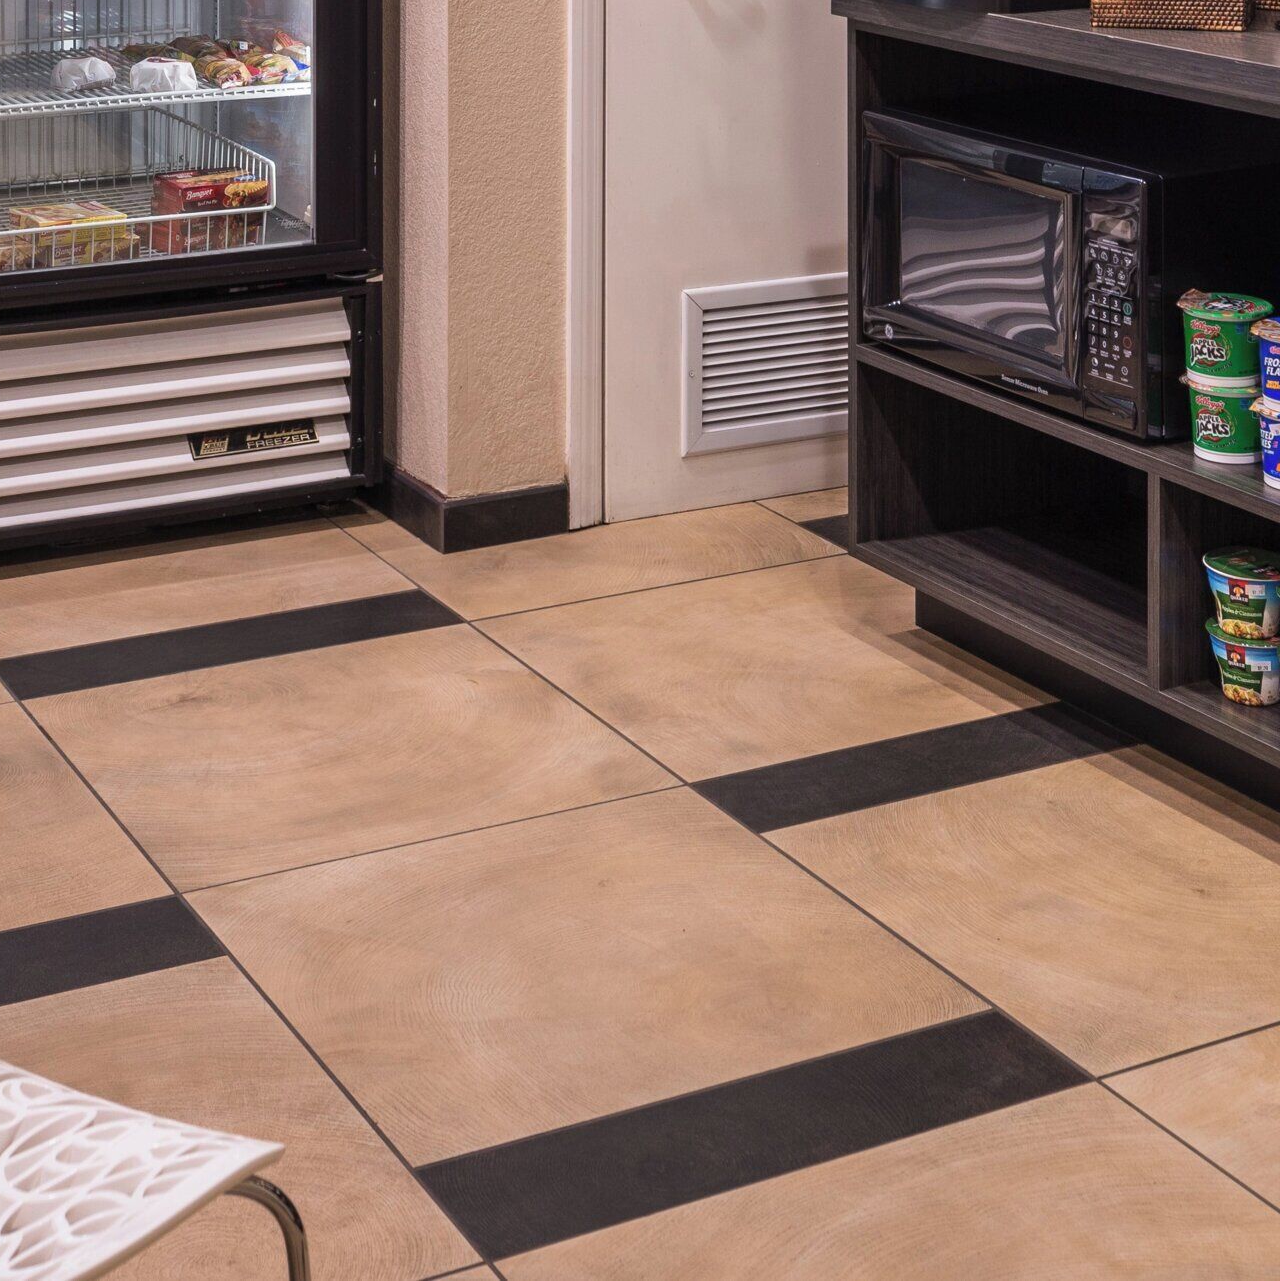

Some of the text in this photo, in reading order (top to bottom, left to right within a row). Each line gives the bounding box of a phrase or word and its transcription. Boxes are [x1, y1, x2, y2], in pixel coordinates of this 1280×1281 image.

[186, 187, 214, 201] Banquet
[1191, 319, 1221, 335] Kellogg's
[1194, 339, 1216, 348] APPLE
[1190, 345, 1226, 366] JACKS
[1196, 395, 1224, 410] Kellogg's
[1199, 414, 1220, 423] APPLE
[1196, 420, 1231, 442] JACKS
[247, 433, 310, 449] FREEZER
